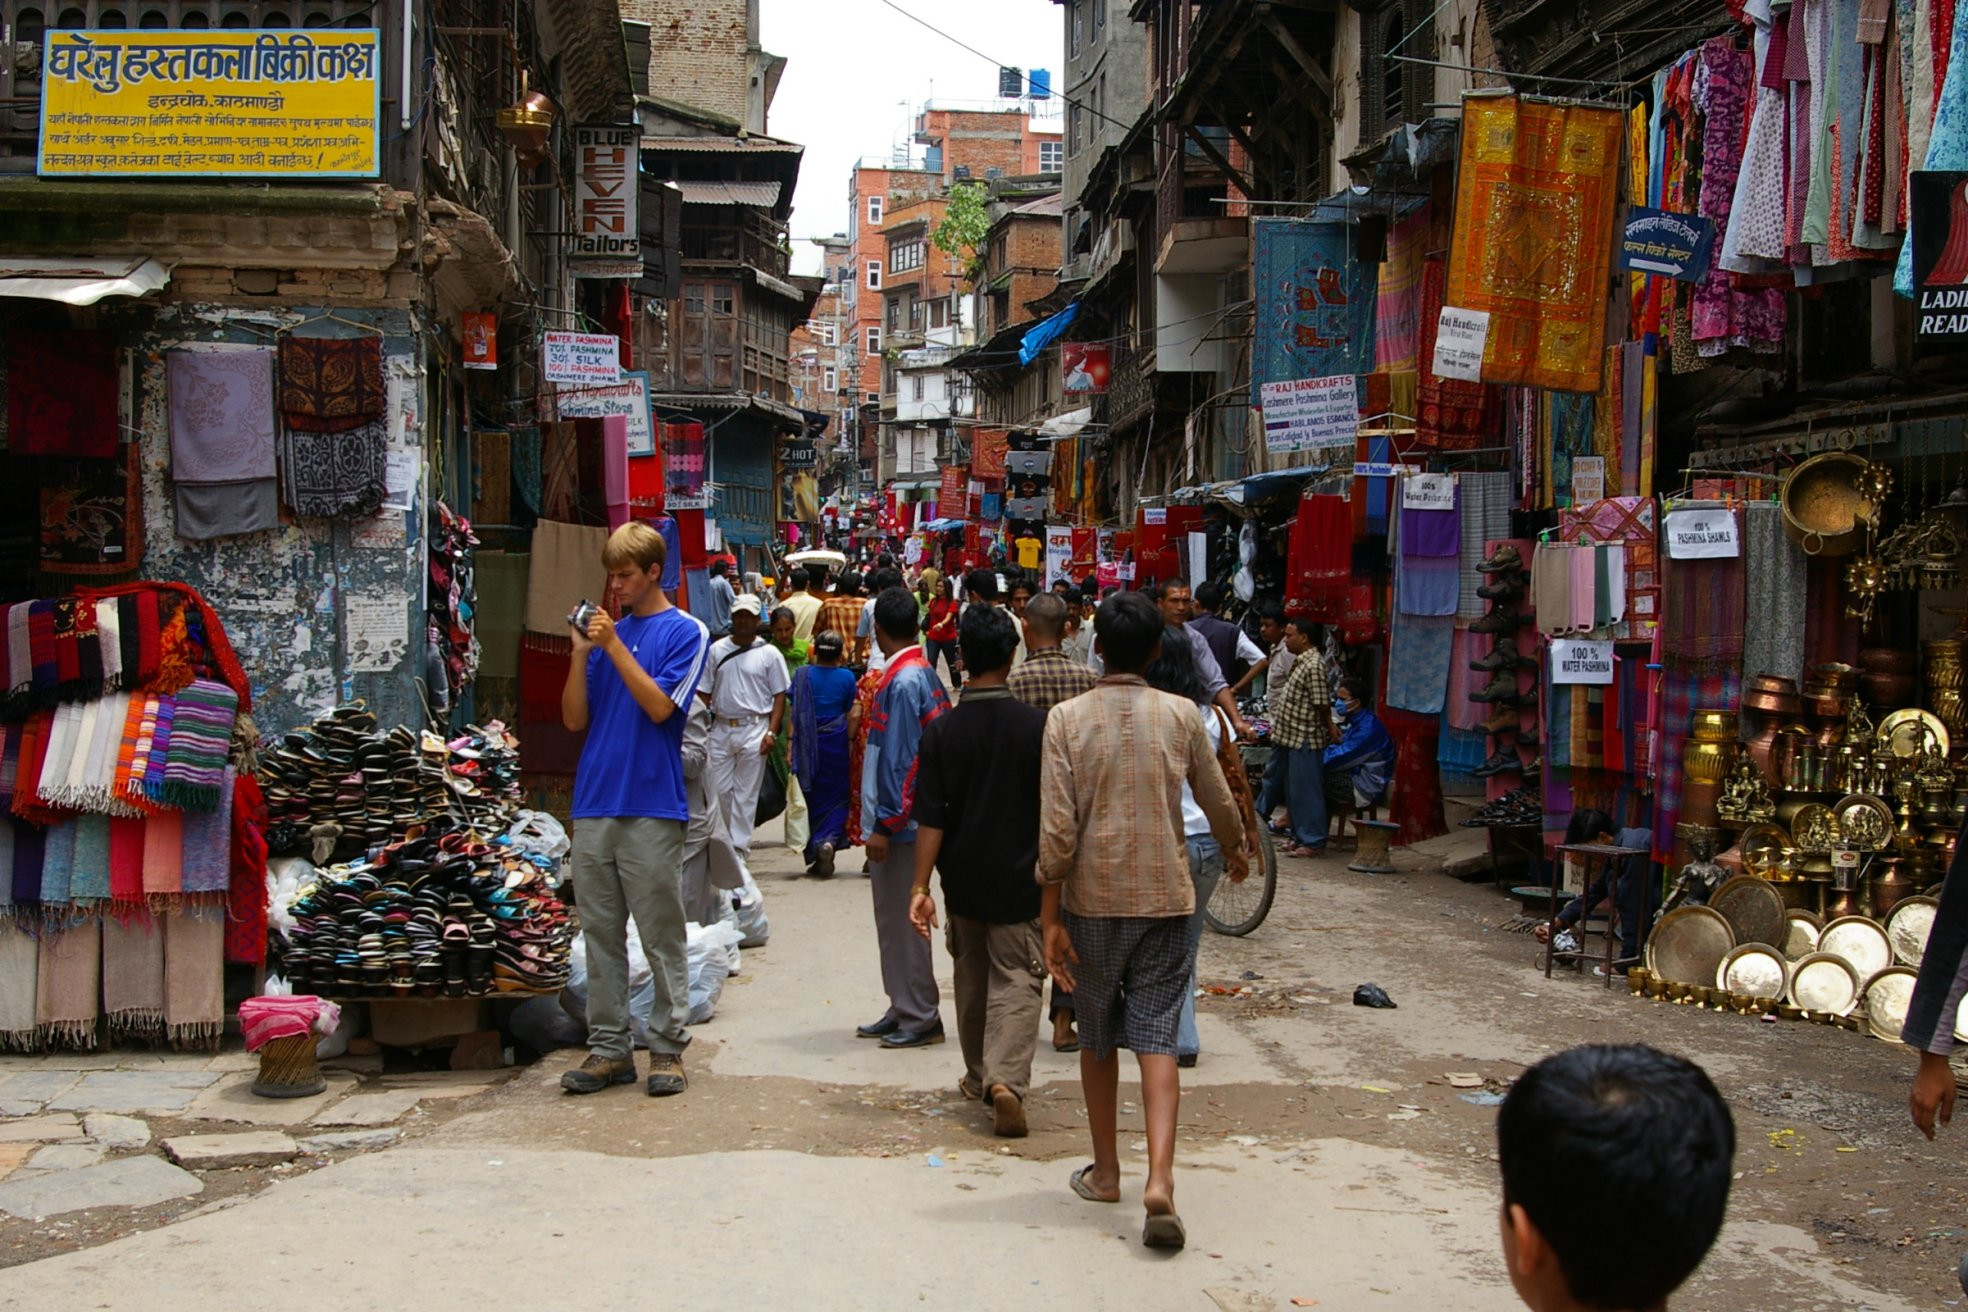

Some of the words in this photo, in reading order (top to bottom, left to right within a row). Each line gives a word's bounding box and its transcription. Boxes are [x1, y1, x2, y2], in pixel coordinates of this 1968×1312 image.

[49, 33, 122, 93] घरेलु
[123, 44, 254, 83] हस्तकला
[255, 34, 316, 82] बिक्री
[317, 42, 376, 81] कक्ष
[579, 131, 632, 145] BLUE
[583, 147, 625, 233] HEVEN
[577, 235, 638, 252] Tailors
[546, 334, 572, 344] WATER
[575, 336, 613, 345] PASHMINA
[570, 345, 614, 355] PASHMINA
[576, 356, 603, 366] SILK
[570, 365, 616, 374] PASHMINA
[546, 372, 587, 382] CASHMERE
[1275, 382, 1292, 393] RAJ
[1294, 376, 1353, 391] HANDICRAFTS
[1295, 390, 1327, 404] Pashmina
[1329, 388, 1355, 402] Gallery
[792, 449, 815, 460] HOT
[1677, 532, 1707, 545] PASHMINA
[1571, 647, 1588, 660] 100
[1590, 647, 1599, 660] %
[1562, 661, 1581, 673] WATER
[1581, 661, 1611, 673] PASHMINA
